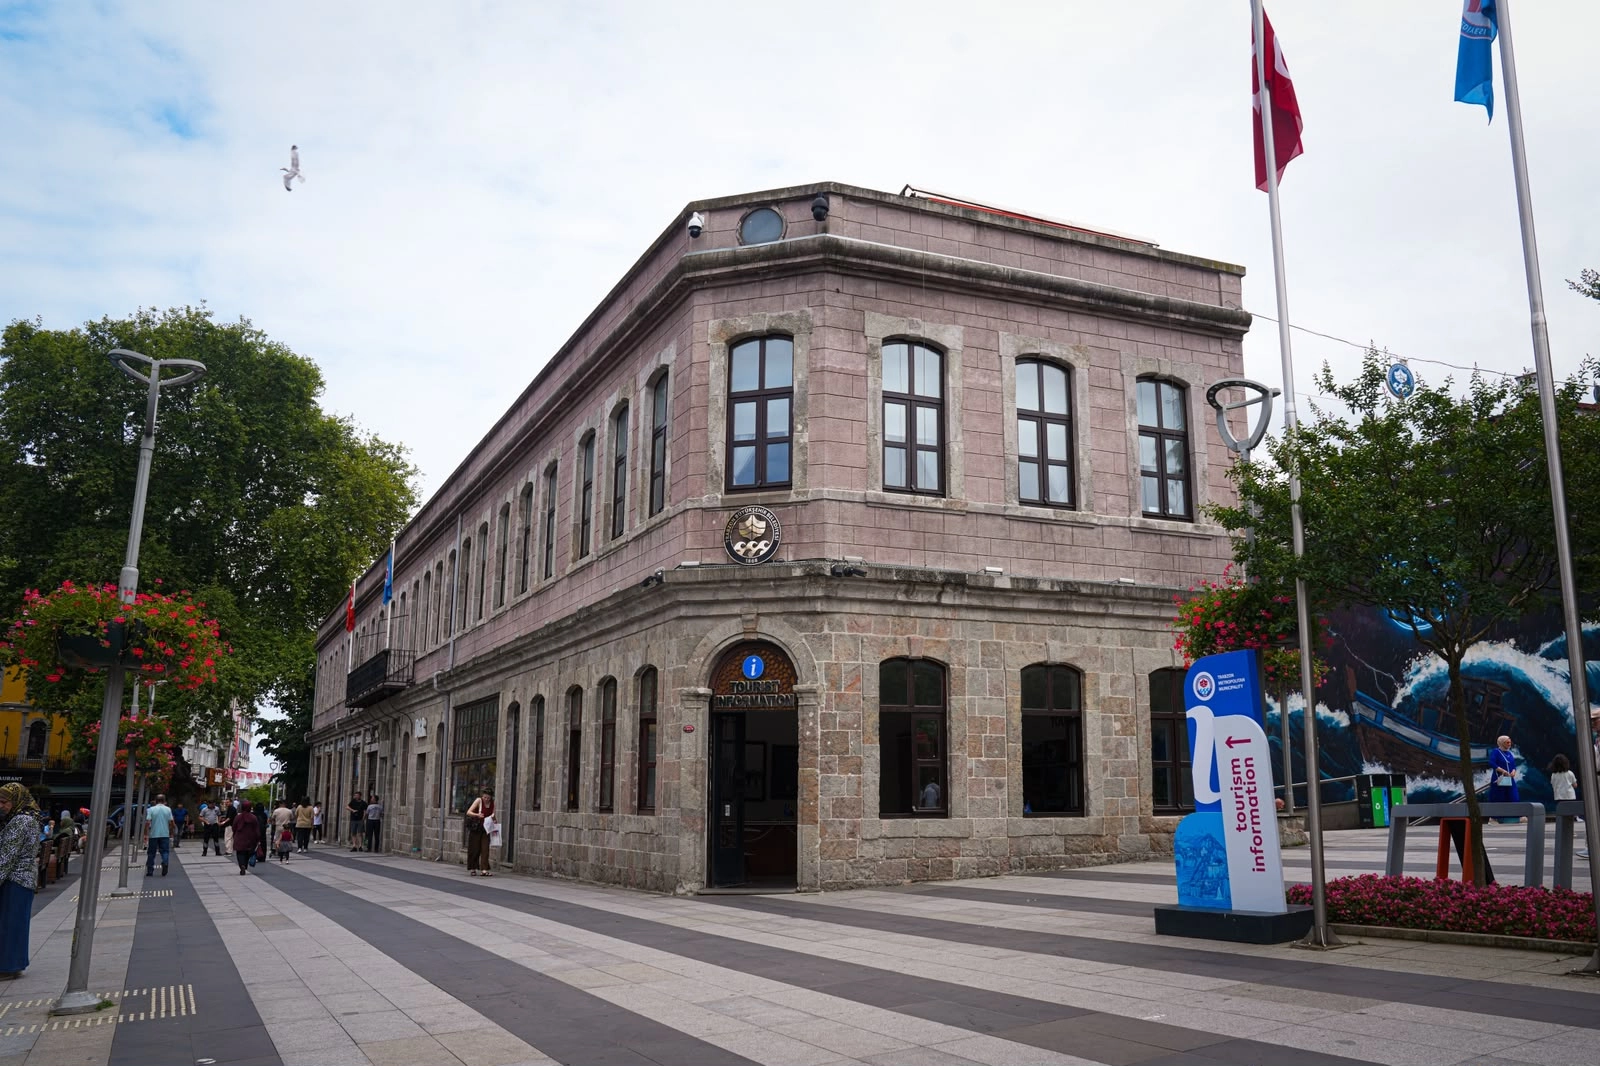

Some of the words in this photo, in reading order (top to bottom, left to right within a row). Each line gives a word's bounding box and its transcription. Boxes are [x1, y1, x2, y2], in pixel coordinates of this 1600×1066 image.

[716, 694, 795, 707] INFORMATION
[729, 680, 780, 693] TOURIST
[1230, 758, 1247, 832] tourism
[1243, 757, 1266, 872] information
